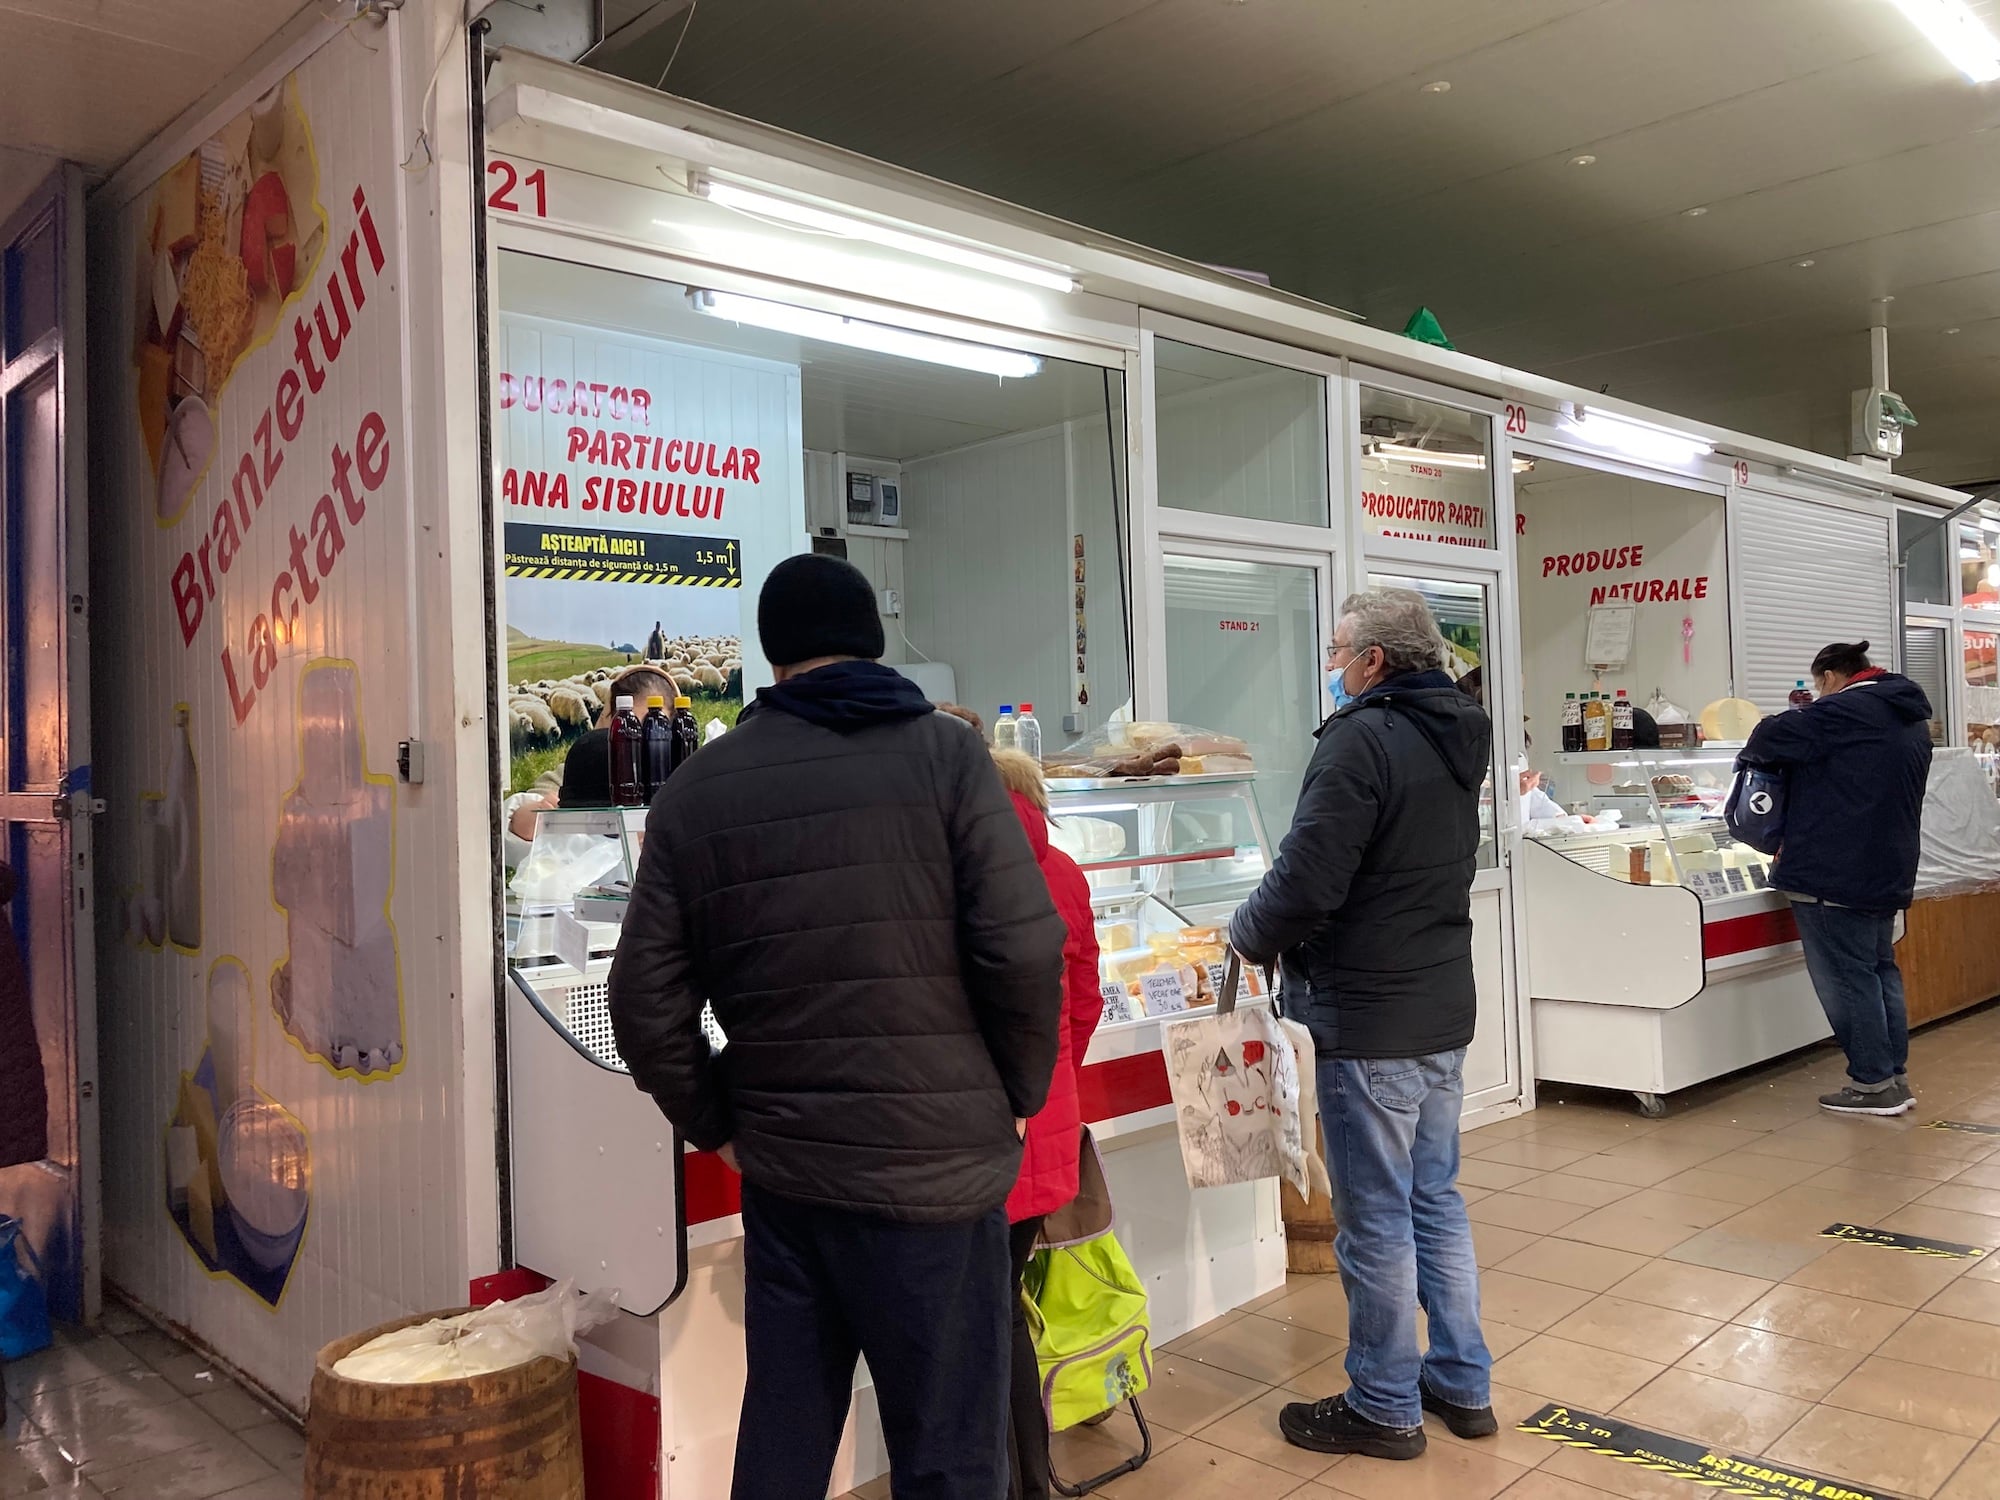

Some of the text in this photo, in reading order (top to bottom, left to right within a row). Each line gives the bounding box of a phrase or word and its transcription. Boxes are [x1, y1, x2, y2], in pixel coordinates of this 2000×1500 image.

[487, 159, 547, 218] 21
[169, 184, 386, 650] Branzeturi
[1505, 404, 1527, 434] 20
[567, 426, 761, 485] PARTICULAR
[1410, 464, 1442, 477] STAND 20
[1734, 460, 1749, 485] 19
[581, 476, 725, 521] SIBIULUI
[1362, 491, 1445, 525] PRODUCATOR
[541, 533, 609, 556] AȘTEAPTĂ
[610, 538, 638, 556] AICI
[695, 550, 728, 565] 1,5 m
[221, 410, 390, 726] Lactate
[505, 553, 550, 565] Păstrează
[589, 558, 601, 568] de
[643, 561, 654, 571] de
[655, 562, 669, 574] 1,5
[669, 565, 679, 573] m
[1542, 545, 1644, 578] PRODUSE
[1589, 577, 1709, 608] NATURALE
[1219, 620, 1260, 631] STAND 21
[1557, 1416, 1612, 1439] 1,5 m
[1769, 1487, 1789, 1498] de
